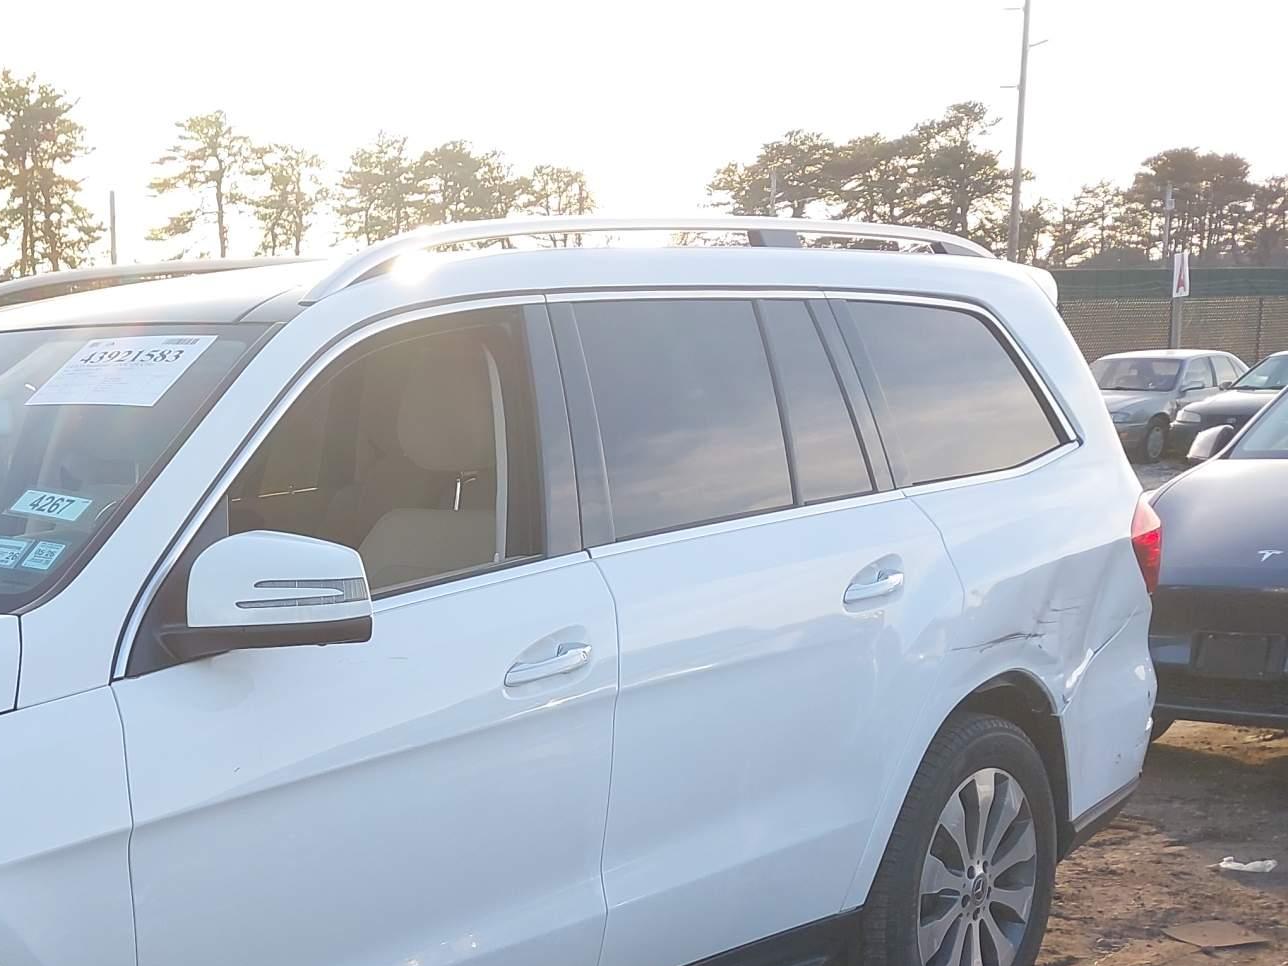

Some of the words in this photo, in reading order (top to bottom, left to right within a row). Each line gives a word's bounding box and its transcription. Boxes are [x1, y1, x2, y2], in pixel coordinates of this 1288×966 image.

[1175, 265, 1186, 293] A
[80, 349, 185, 364] 43921583
[29, 494, 75, 515] 4267
[5, 551, 20, 561] 26
